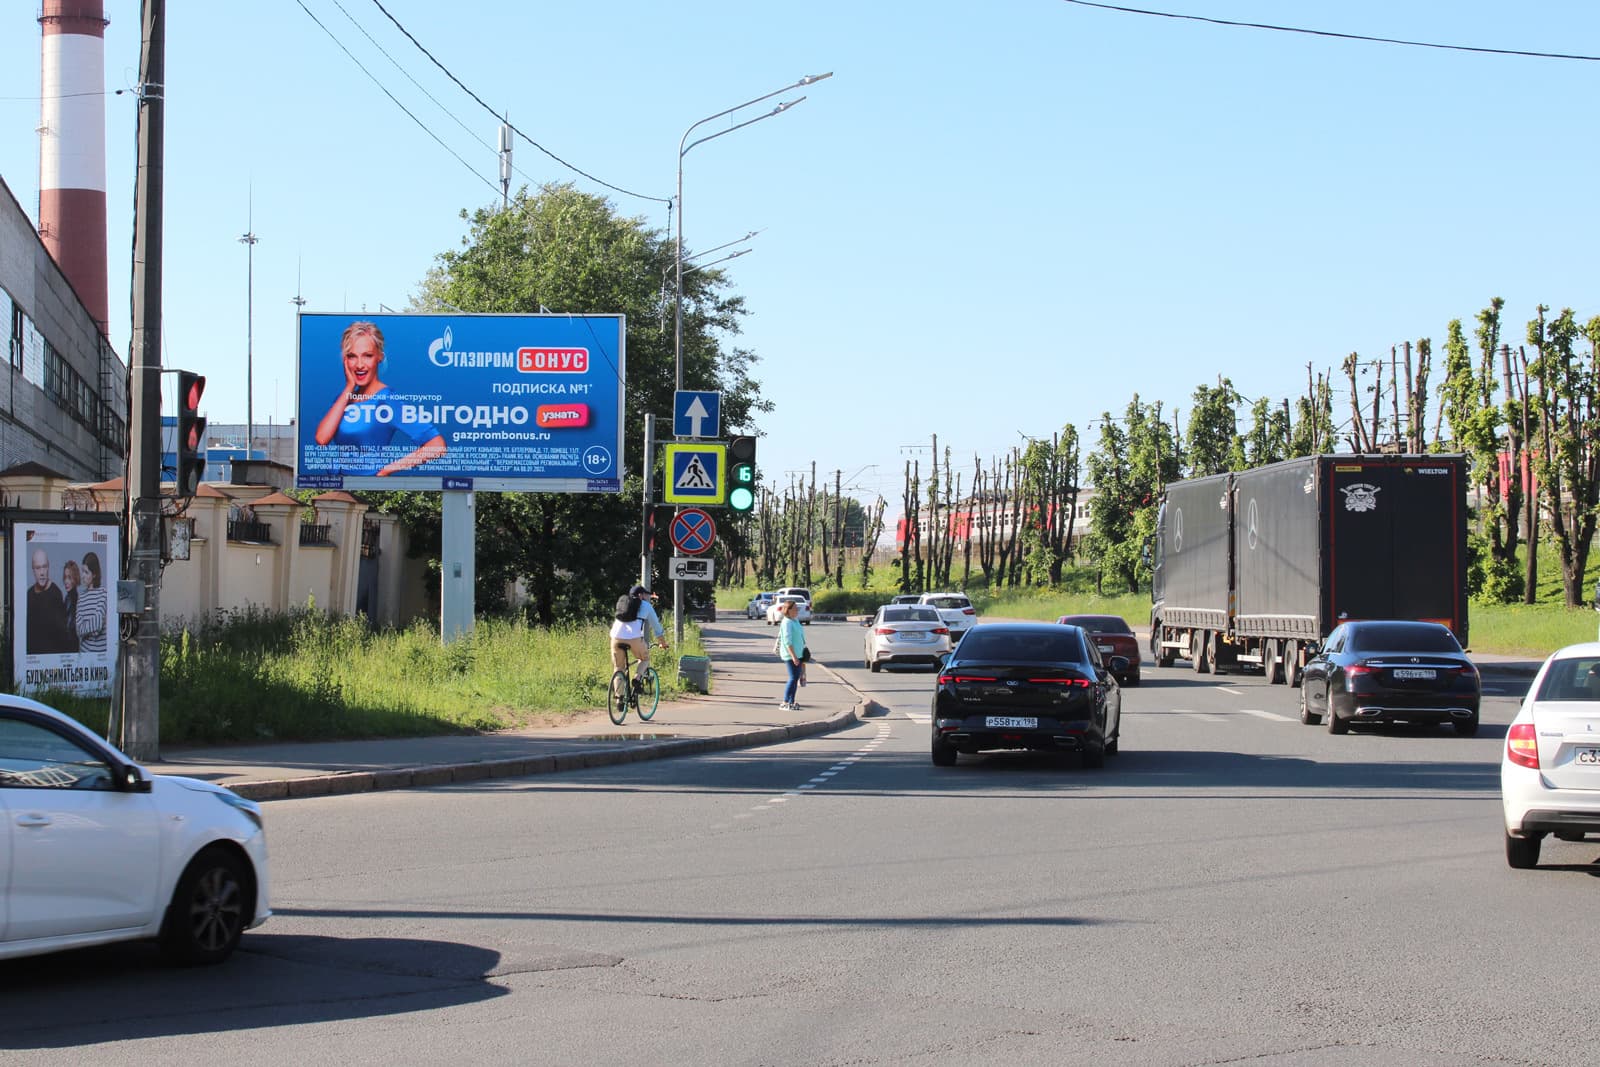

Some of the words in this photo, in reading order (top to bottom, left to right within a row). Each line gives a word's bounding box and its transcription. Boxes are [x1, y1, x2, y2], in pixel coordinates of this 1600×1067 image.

[454, 351, 514, 368] ГАЗПРОМ
[522, 352, 584, 368] БОНУС
[492, 383, 566, 395] ПОДПИСКА
[345, 392, 442, 403] Подписка-конструктор
[343, 404, 394, 423] ЭТО
[401, 404, 529, 428] ВЫГОДНО
[542, 411, 580, 422] узнать
[453, 431, 551, 441] gazprombonus.ru
[587, 454, 608, 465] 18+
[45, 667, 83, 683] СНИМАТЬСЯ
[84, 667, 89, 681] В
[90, 666, 108, 681] КИНО
